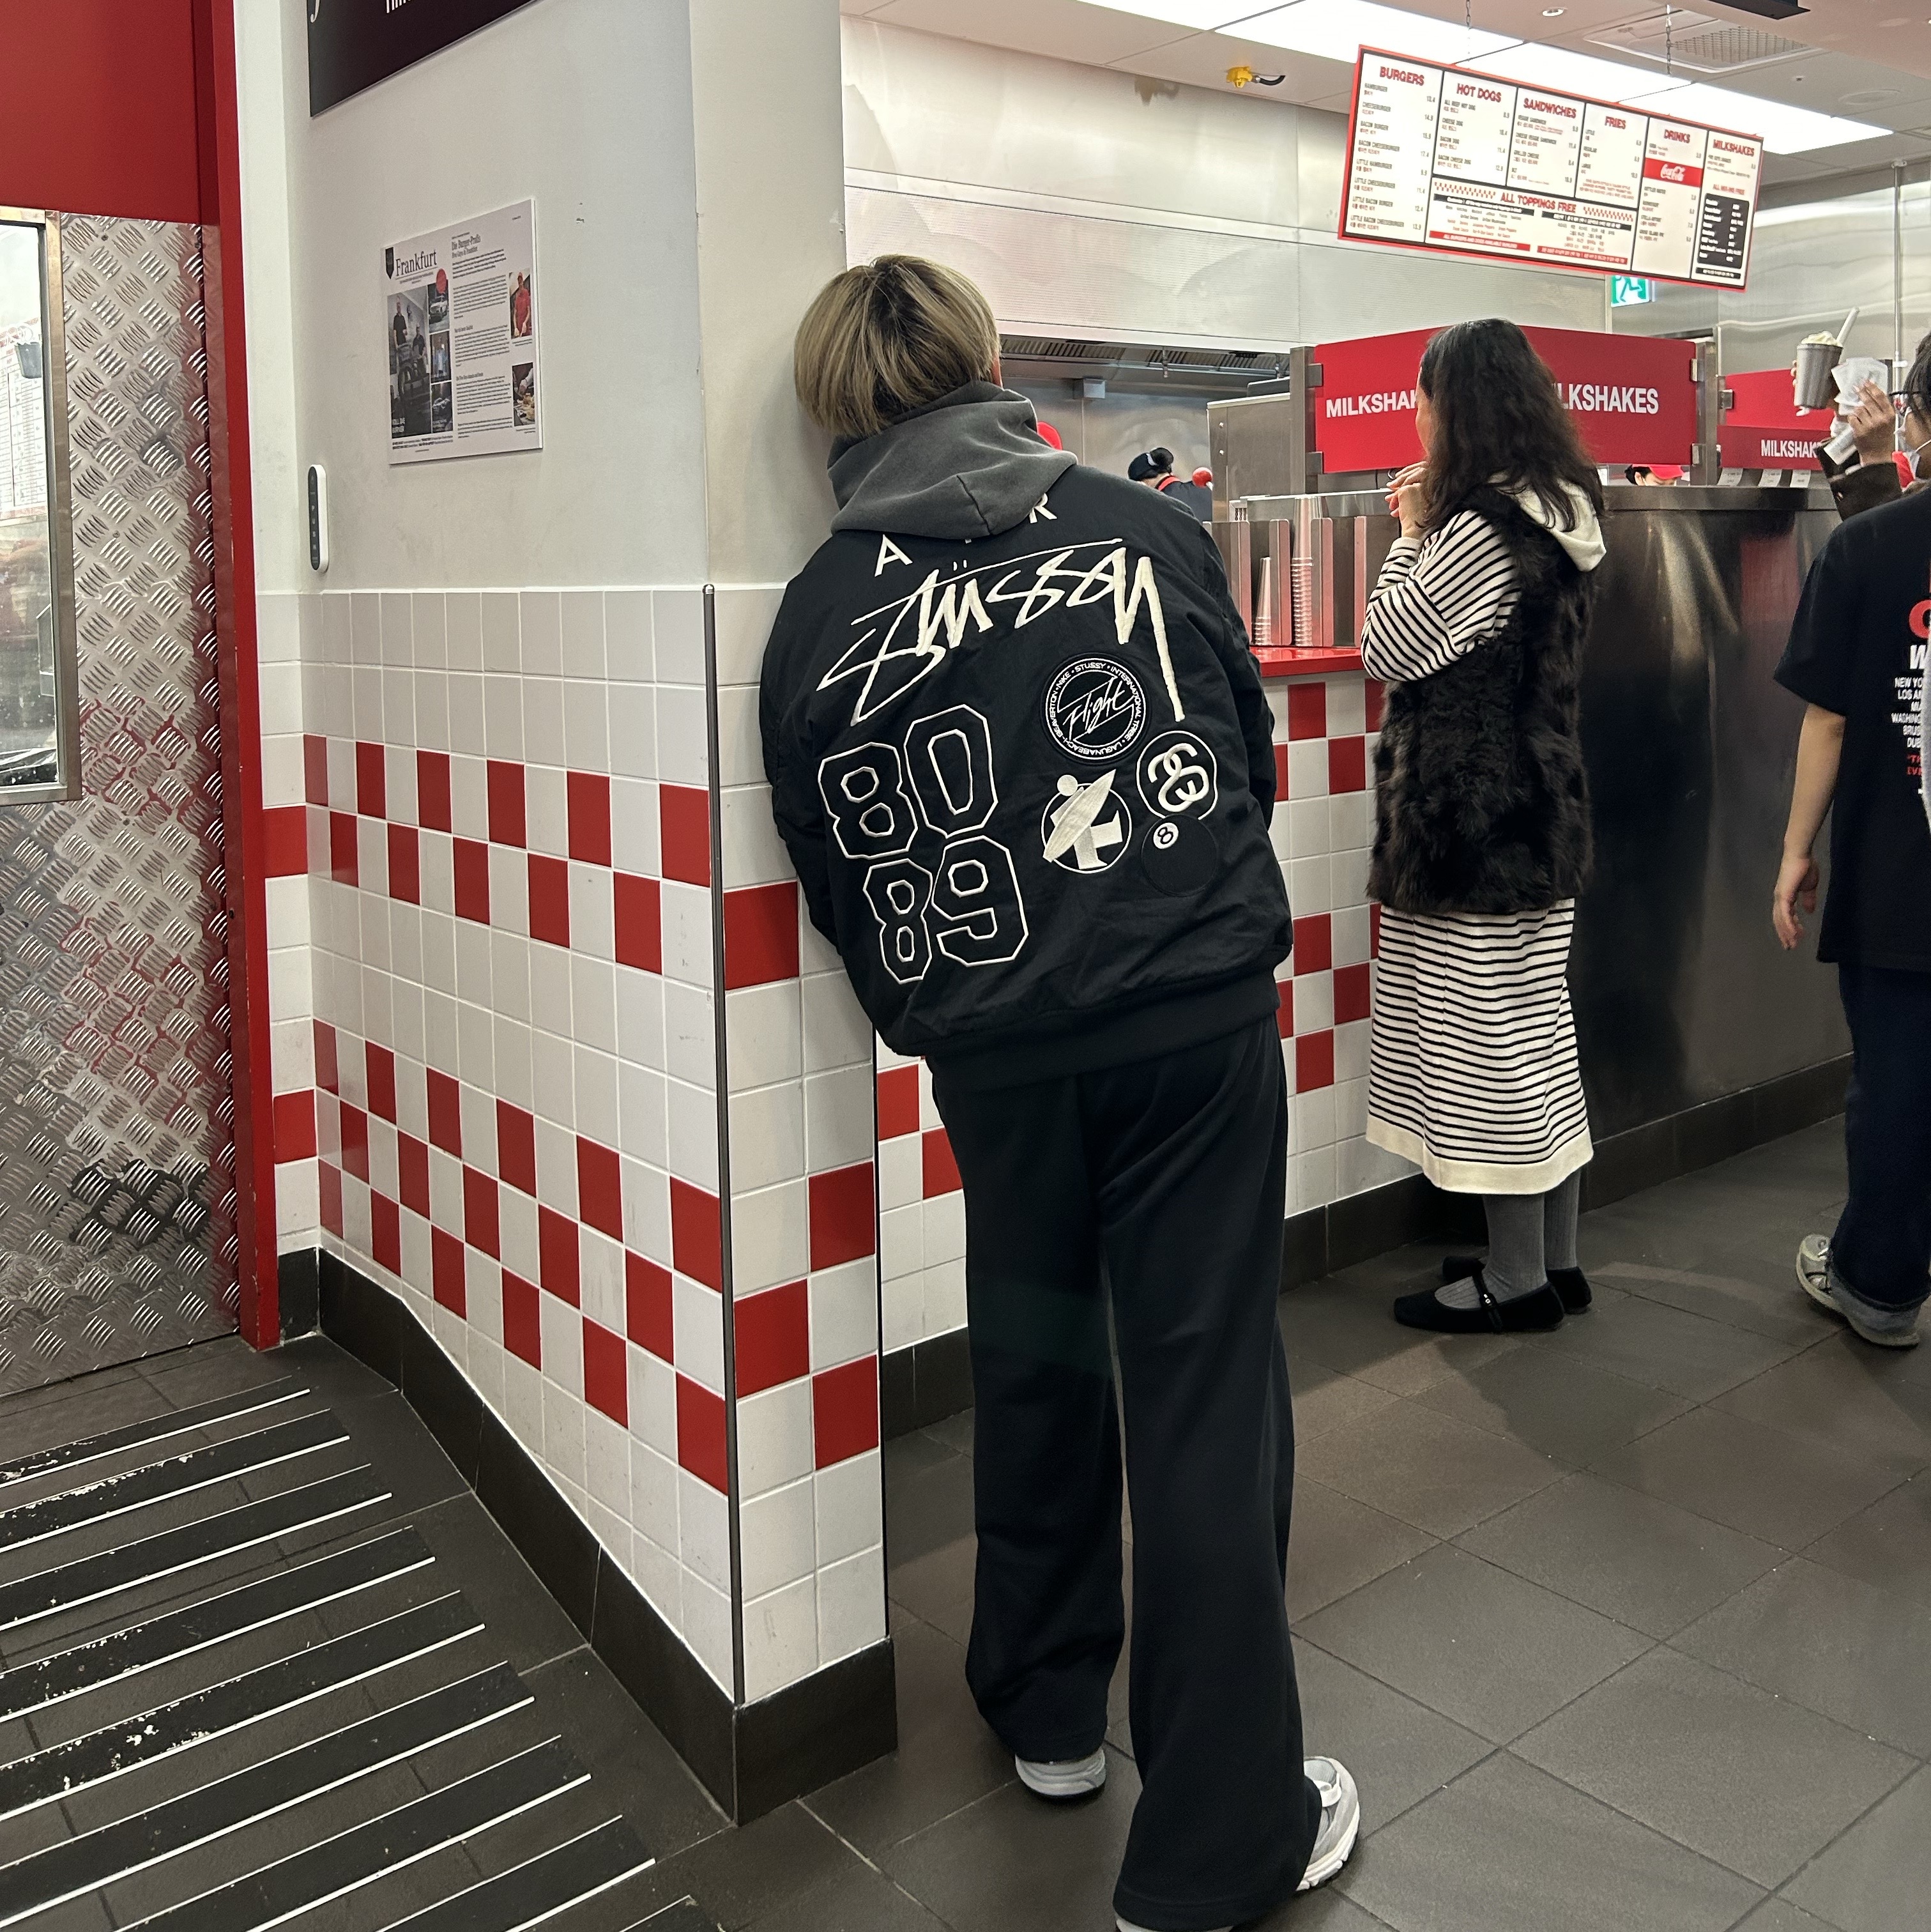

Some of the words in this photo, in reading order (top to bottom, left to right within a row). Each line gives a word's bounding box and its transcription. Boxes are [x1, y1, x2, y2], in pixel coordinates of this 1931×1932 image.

[1379, 66, 1424, 86] BURGERS
[1456, 83, 1476, 97] HOT
[1477, 88, 1502, 103] DOGS
[1523, 98, 1576, 119] SANDWICHES
[1604, 116, 1626, 130] FRIES
[1663, 129, 1690, 144] DRINKS
[1713, 139, 1755, 157] MILKSHAKES
[1500, 192, 1515, 203] ALL
[1518, 194, 1555, 210] TOPPINGS
[1557, 201, 1576, 213] FREE
[395, 249, 438, 277] Frankfurt
[1326, 389, 1416, 418] MILKSHA
[1553, 383, 1659, 415] LKSHAKES
[1761, 439, 1820, 458] MILKSHAK
[874, 493, 1057, 577] AR
[1074, 662, 1106, 673] STUSSY
[1056, 671, 1071, 689] NIKE
[1895, 677, 1912, 688] NEW
[1913, 677, 1923, 687] YO
[1110, 666, 1141, 719] INTERNATIONAL
[1898, 689, 1912, 700] LOS
[1049, 690, 1064, 738] BEAVERTON
[1062, 677, 1126, 741] Flight
[1891, 713, 1921, 724] WASHIN
[1124, 720, 1140, 742] TRIBE
[817, 703, 998, 860] 80
[862, 835, 1029, 985] 89
